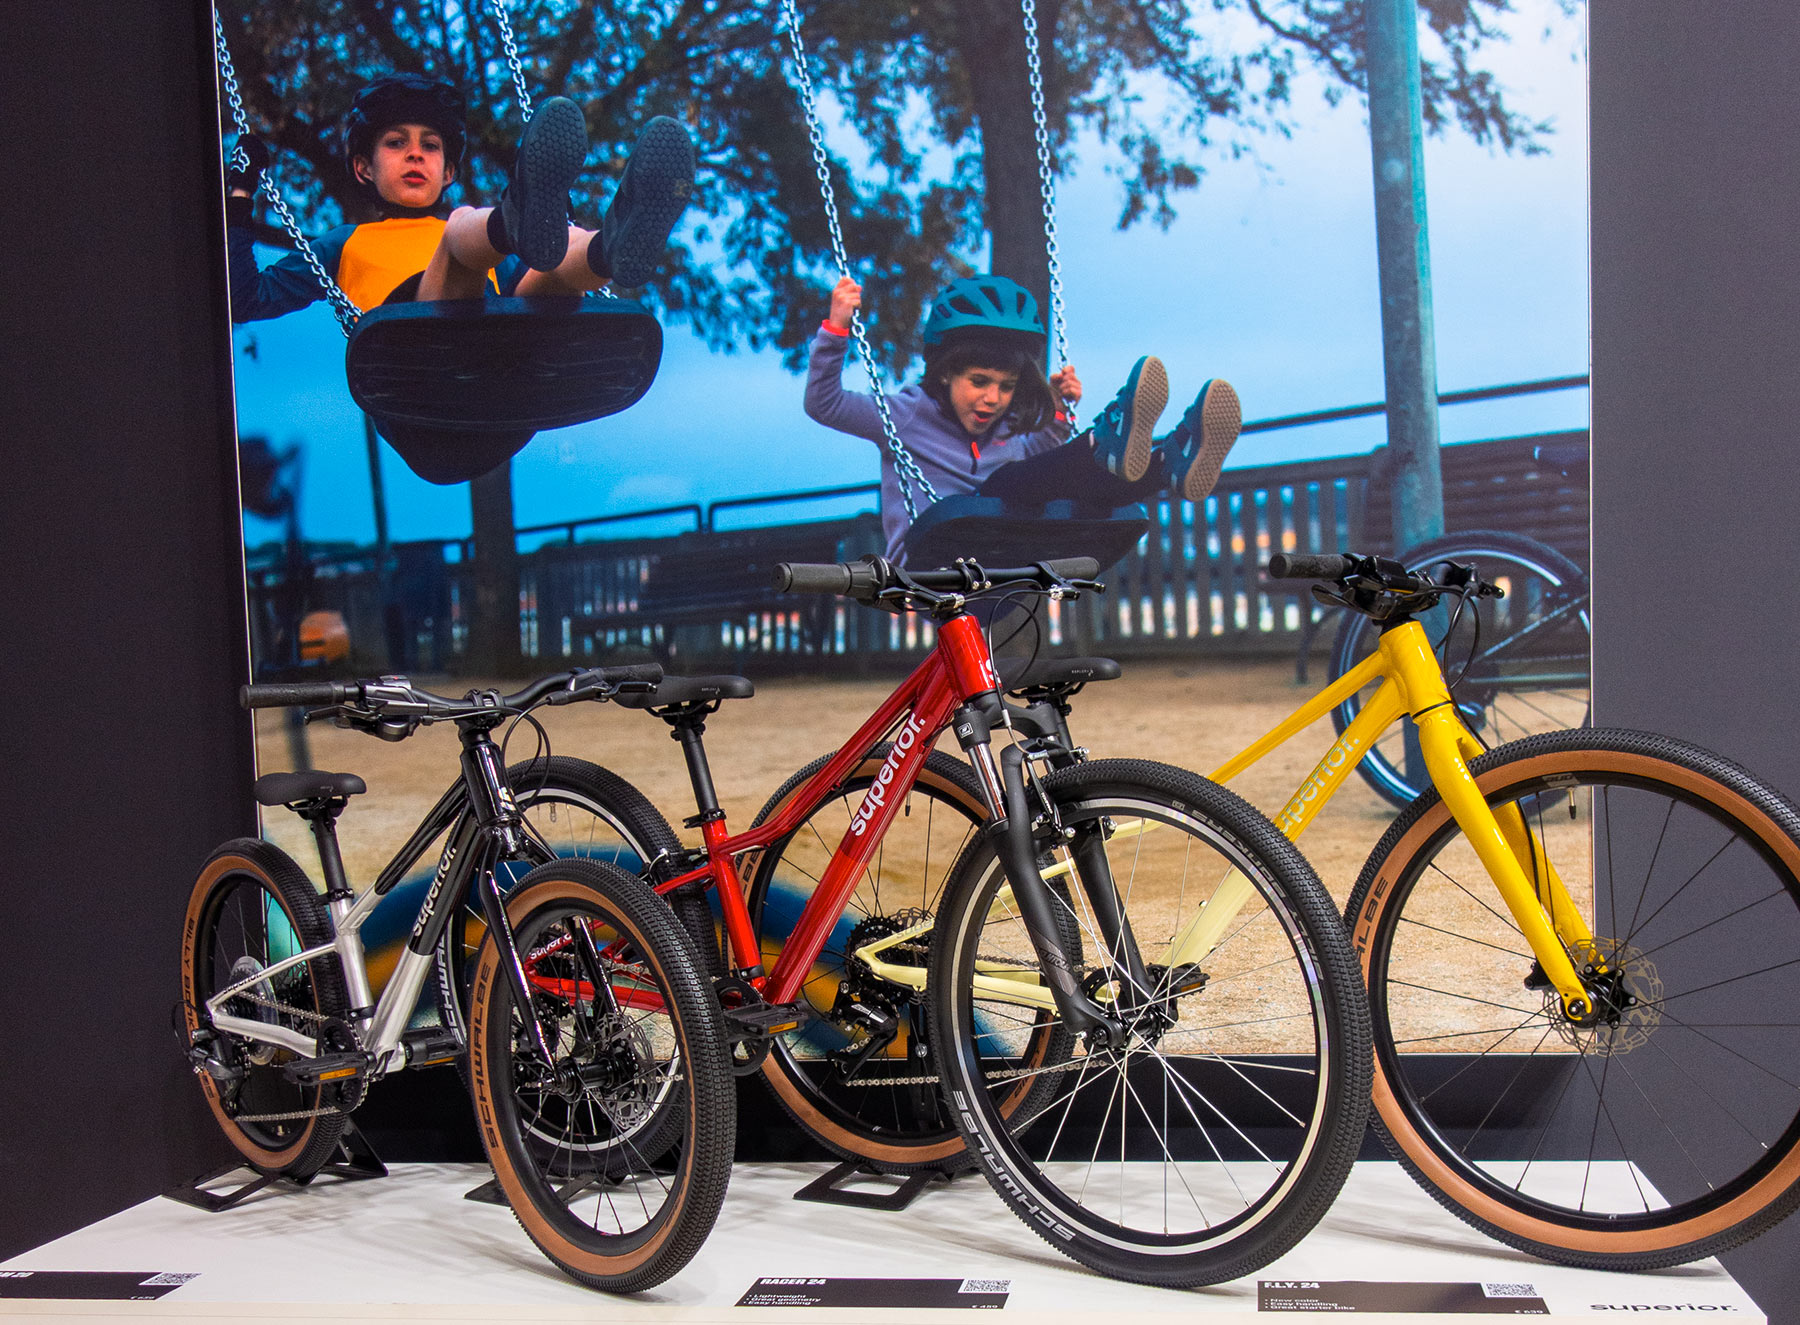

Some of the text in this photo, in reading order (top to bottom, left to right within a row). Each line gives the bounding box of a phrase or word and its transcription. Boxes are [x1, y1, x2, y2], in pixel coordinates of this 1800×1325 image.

[851, 712, 926, 836] superior.
[1279, 733, 1360, 833] uperior.
[412, 847, 457, 937] superior.
[436, 937, 464, 1046] SCHWAL
[471, 962, 499, 1149] SCHWALBE
[952, 1090, 1077, 1241] SCHWALBE
[806, 1278, 827, 1286] 24
[1589, 1303, 1738, 1312] superior.
